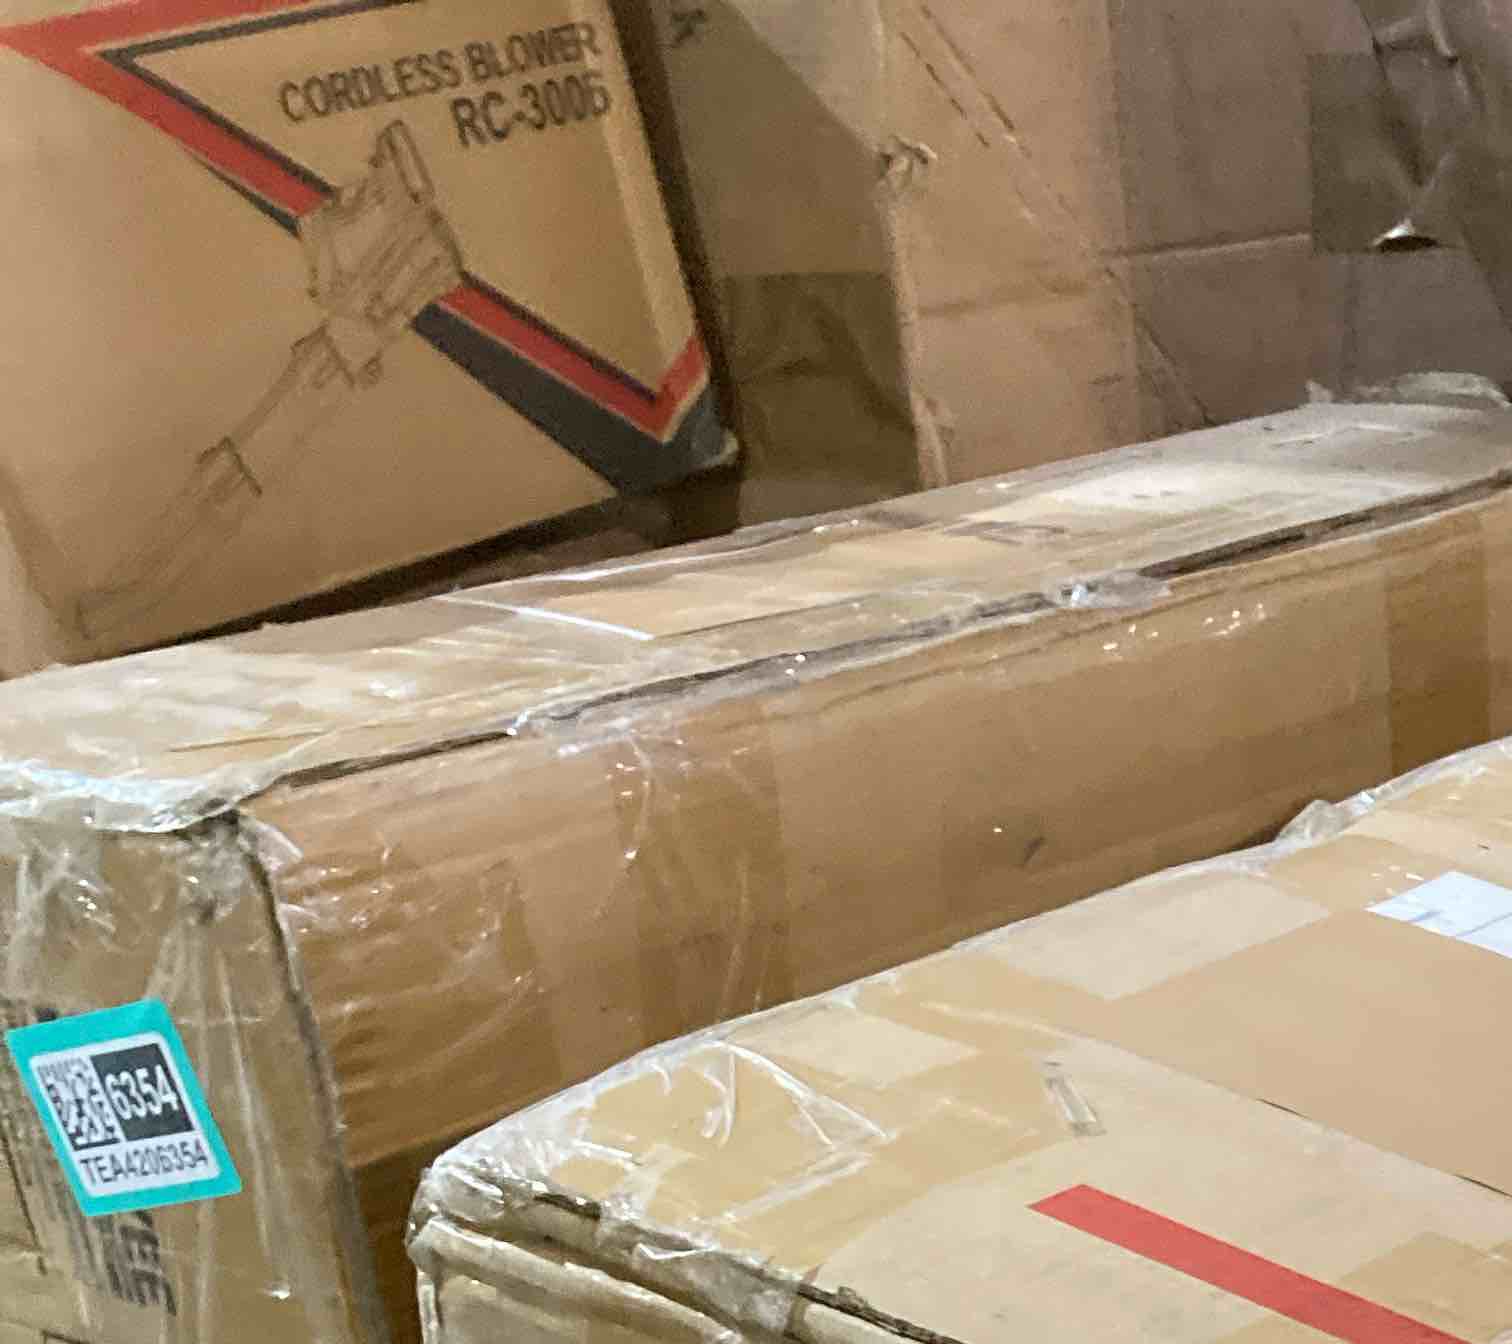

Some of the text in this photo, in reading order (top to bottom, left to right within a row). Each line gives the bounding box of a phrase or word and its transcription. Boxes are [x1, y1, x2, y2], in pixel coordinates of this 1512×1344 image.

[279, 22, 600, 122] CORDLESS BLOWER
[105, 1063, 181, 1120] 6354
[79, 1142, 208, 1187] TEA4206354
